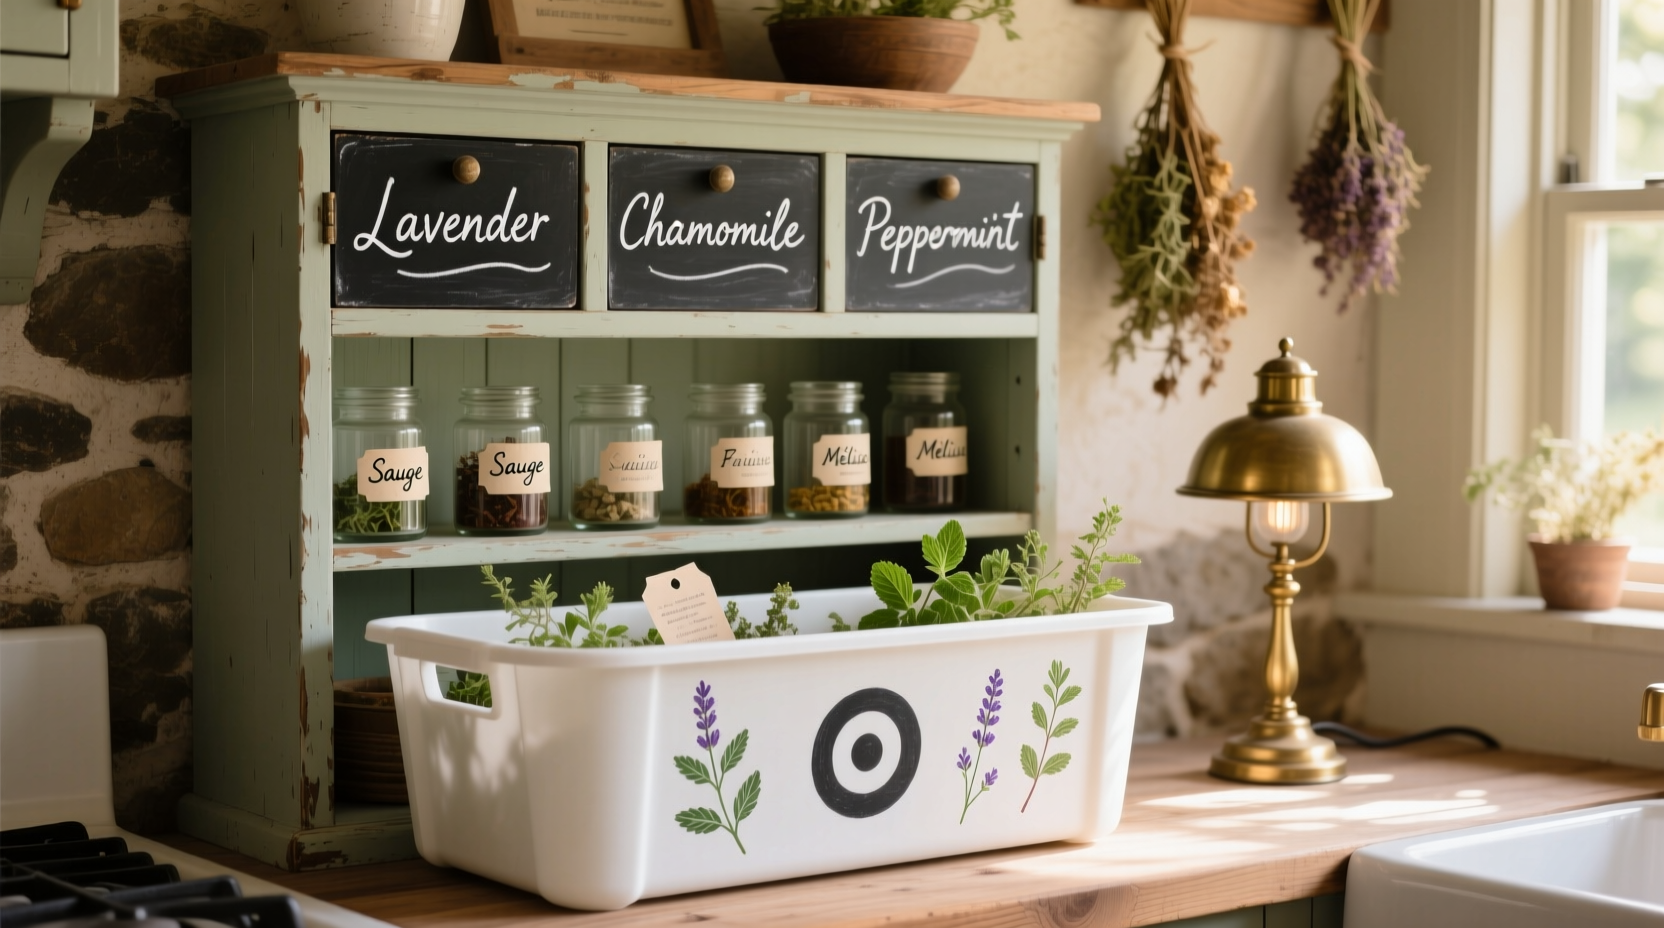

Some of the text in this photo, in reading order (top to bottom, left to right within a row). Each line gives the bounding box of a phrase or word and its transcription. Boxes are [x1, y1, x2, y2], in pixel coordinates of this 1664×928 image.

[353, 177, 550, 258] Lavender
[619, 192, 806, 251] Chamomile
[856, 195, 1024, 274] Peppermint
[368, 457, 424, 492] Sauge
[489, 451, 545, 487] Sauge
